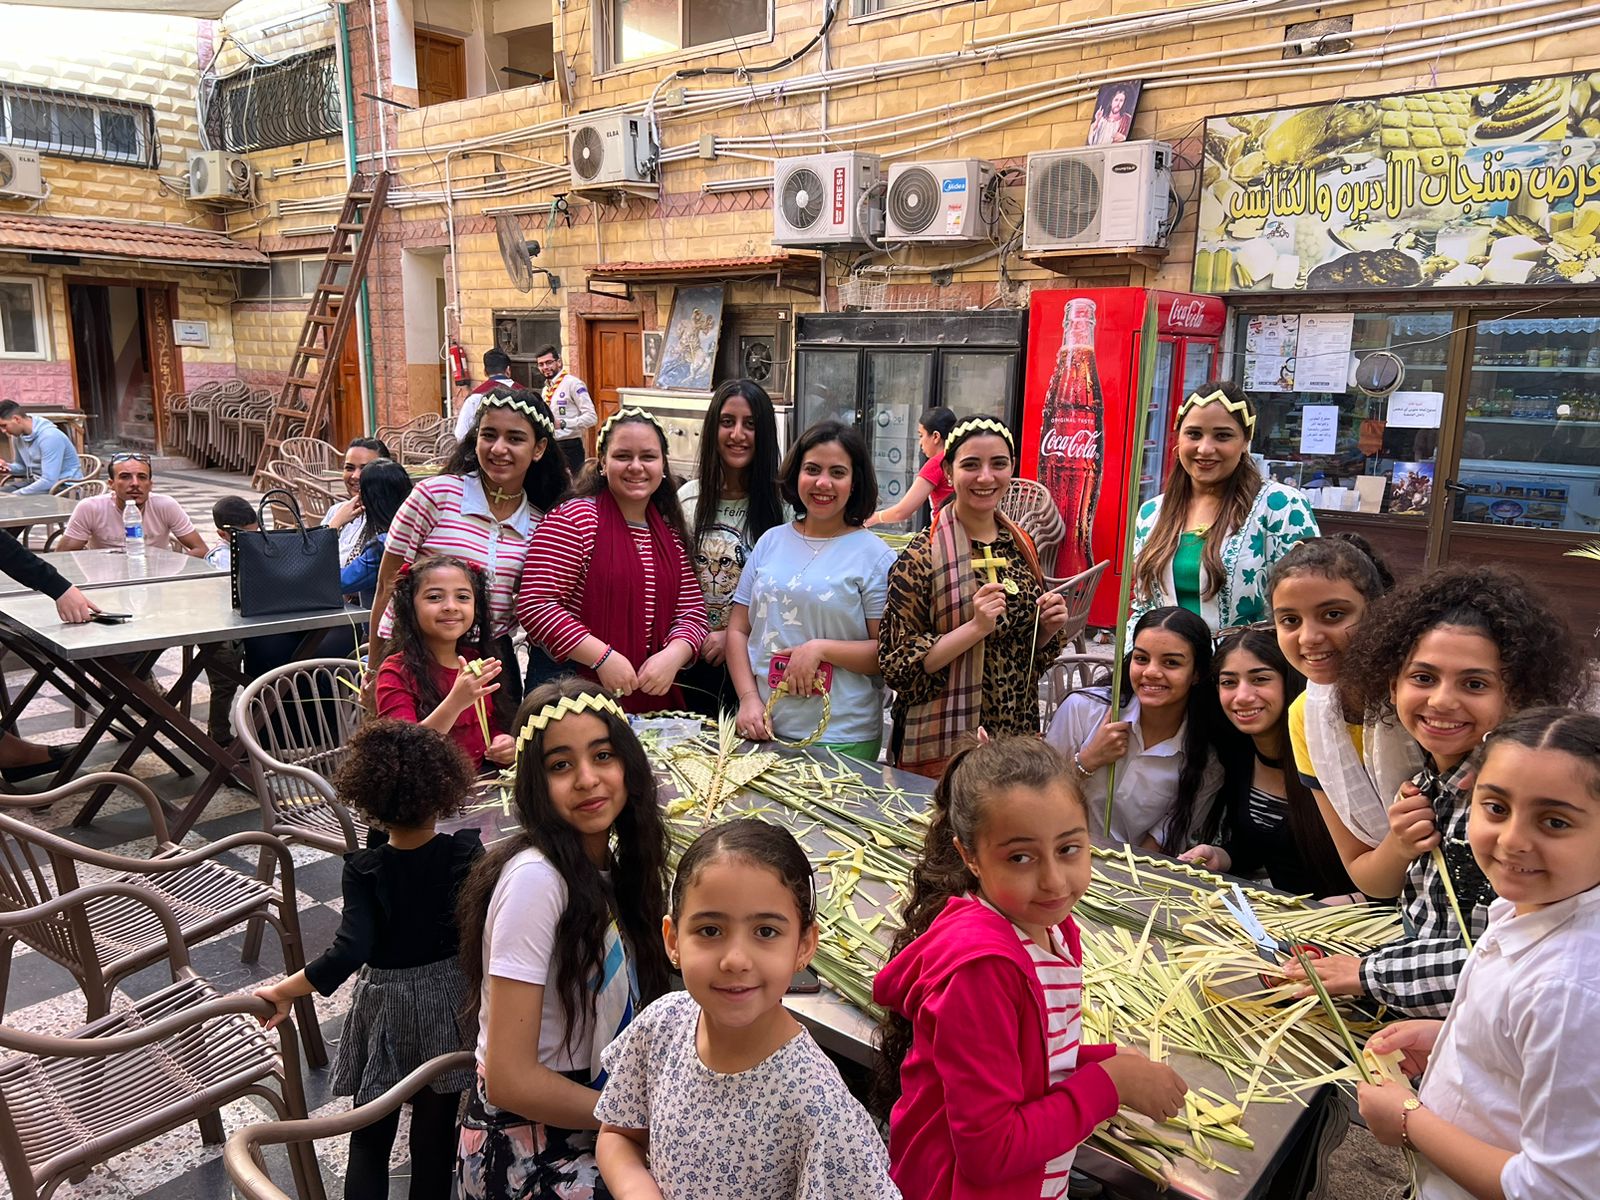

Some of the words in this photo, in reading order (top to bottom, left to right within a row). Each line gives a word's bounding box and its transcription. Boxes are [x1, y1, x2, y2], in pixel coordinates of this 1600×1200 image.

[836, 169, 844, 208] FRESH
[1229, 168, 1332, 222] والكنائس
[1336, 151, 1415, 221] الأديرة
[1420, 150, 1522, 214] منتجات
[1528, 145, 1600, 208] عرض
[1167, 297, 1206, 328] Coca-Cola
[1041, 428, 1103, 459] Coca-Cola
[717, 506, 750, 517] -fein
